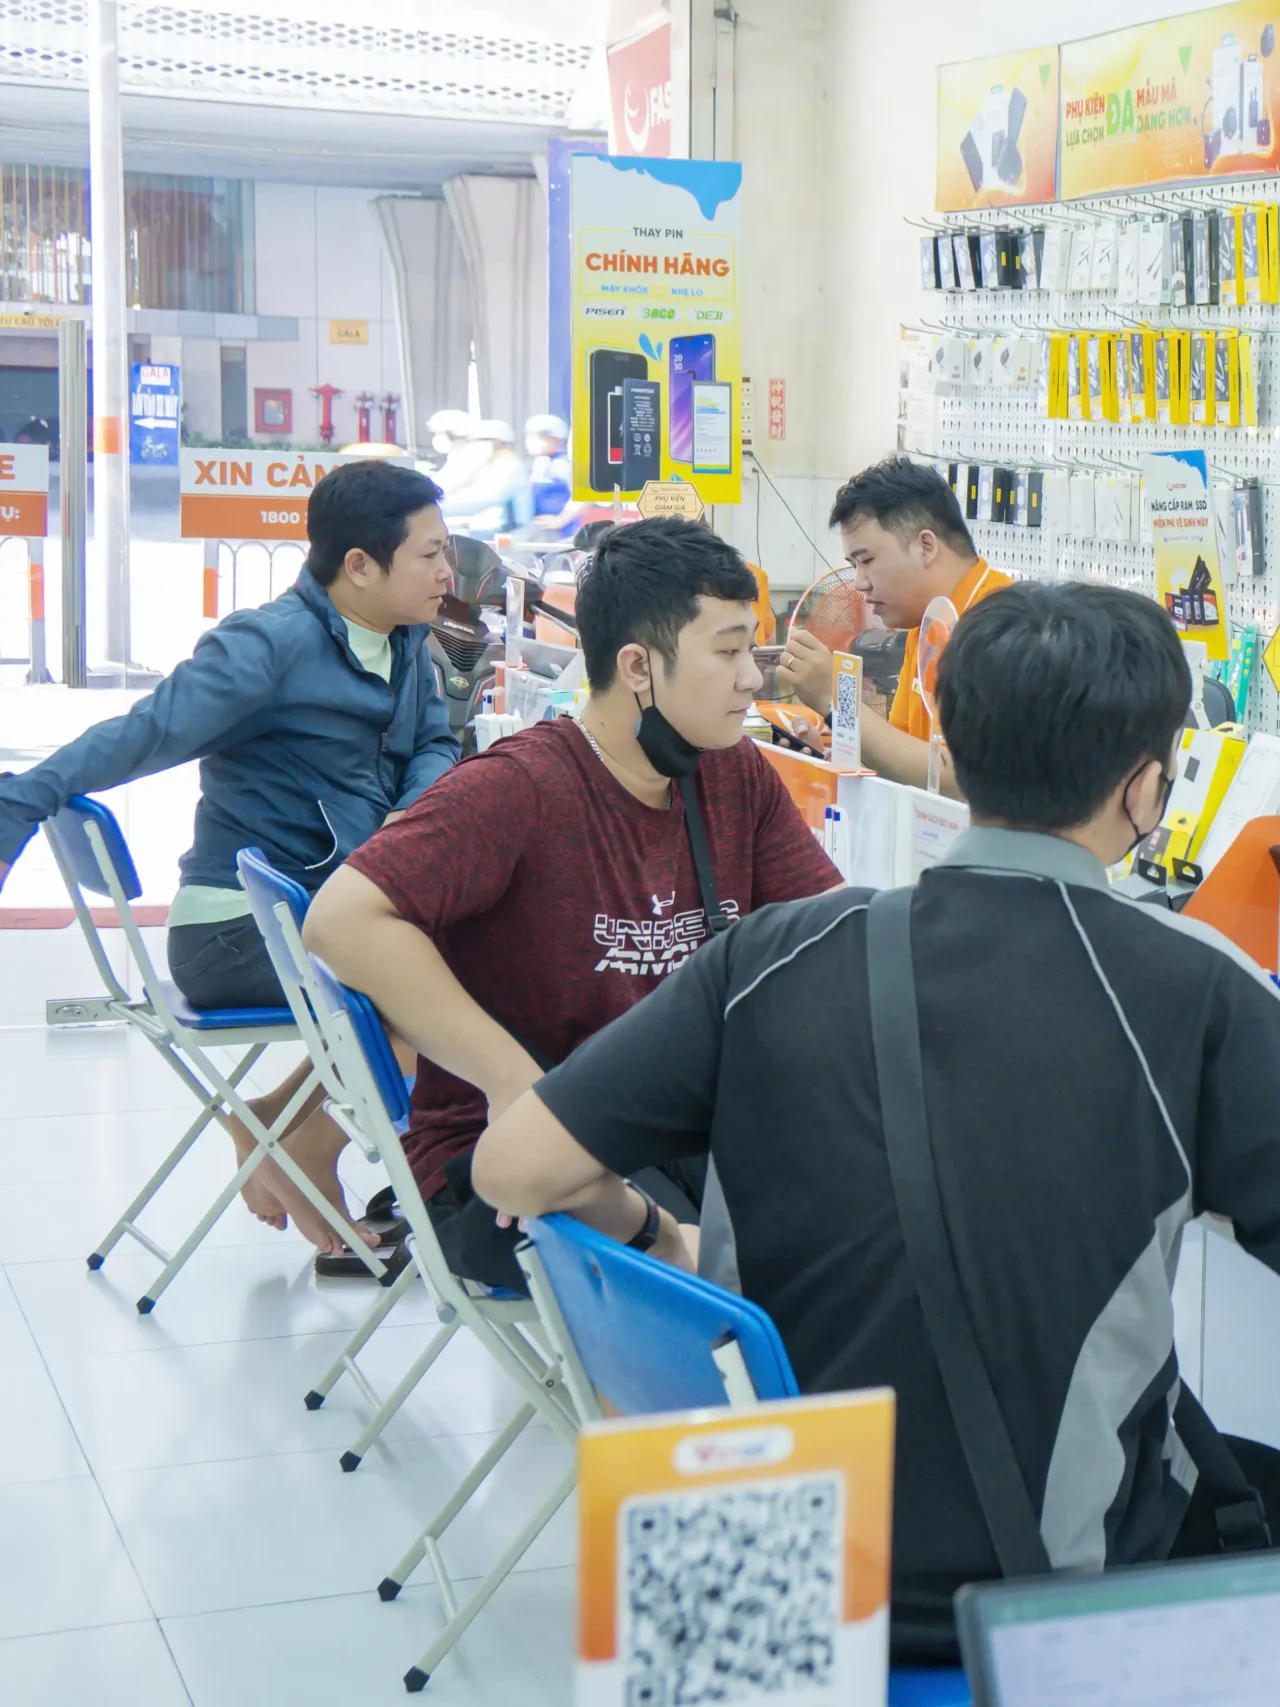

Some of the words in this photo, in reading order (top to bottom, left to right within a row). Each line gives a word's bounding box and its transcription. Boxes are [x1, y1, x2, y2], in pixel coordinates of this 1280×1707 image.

[1066, 101, 1083, 123] PHỤ
[1086, 92, 1105, 120] KIỆN
[1082, 125, 1104, 146] CHỌN
[633, 227, 662, 238] THAY
[665, 229, 684, 238] PIN
[585, 249, 658, 274] CHÍNH
[585, 307, 625, 316] PISEN
[674, 354, 683, 362] 20
[674, 362, 683, 370] 30
[194, 460, 252, 485] XIN
[1151, 499, 1167, 511] NÂNG
[1168, 497, 1179, 511] CẤP
[1196, 500, 1207, 510] SSD
[260, 511, 300, 524] 1800
[594, 940, 698, 975] ARMO
